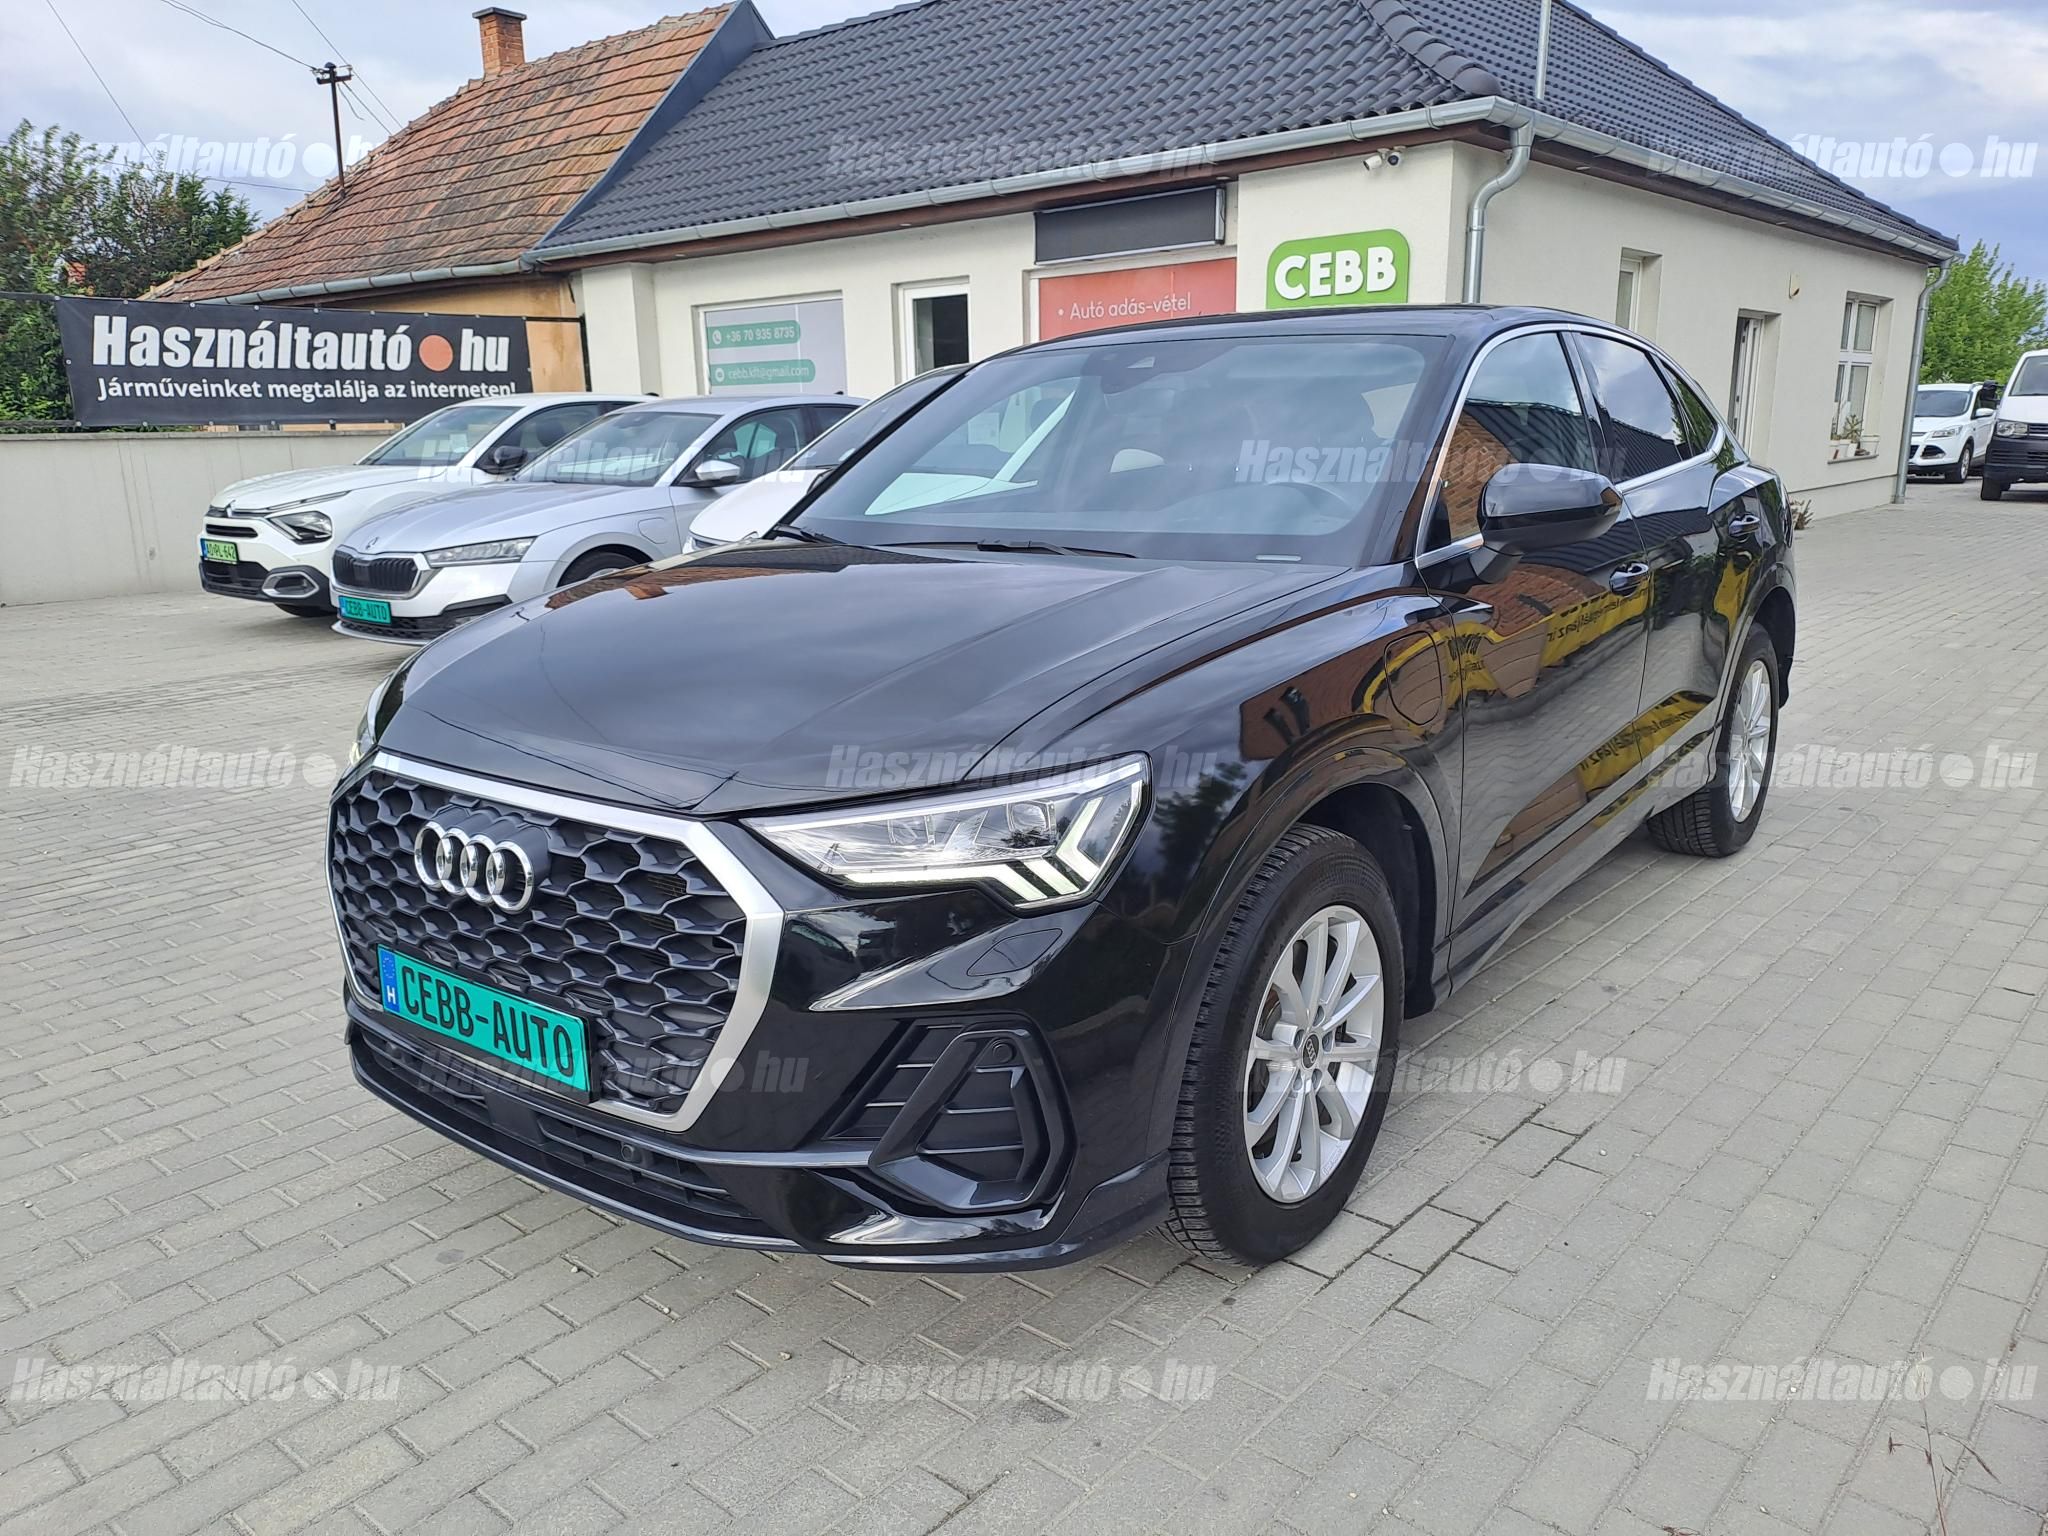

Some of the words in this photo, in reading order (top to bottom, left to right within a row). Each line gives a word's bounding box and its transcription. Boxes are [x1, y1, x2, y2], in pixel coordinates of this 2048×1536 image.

[1274, 246, 1397, 300] CEBB
[1069, 301, 1105, 320] Autó
[1108, 291, 1191, 318] adás-vétel
[726, 330, 742, 343] +36
[744, 329, 754, 341] 70
[755, 328, 772, 340] 935
[773, 326, 796, 339] 8735
[97, 376, 262, 401] Járműveinket
[267, 379, 379, 403] megtalálja
[384, 383, 407, 398] az
[410, 380, 516, 398] interneten!
[386, 985, 397, 1005] H
[402, 965, 575, 1078] CEBB-AUTO
